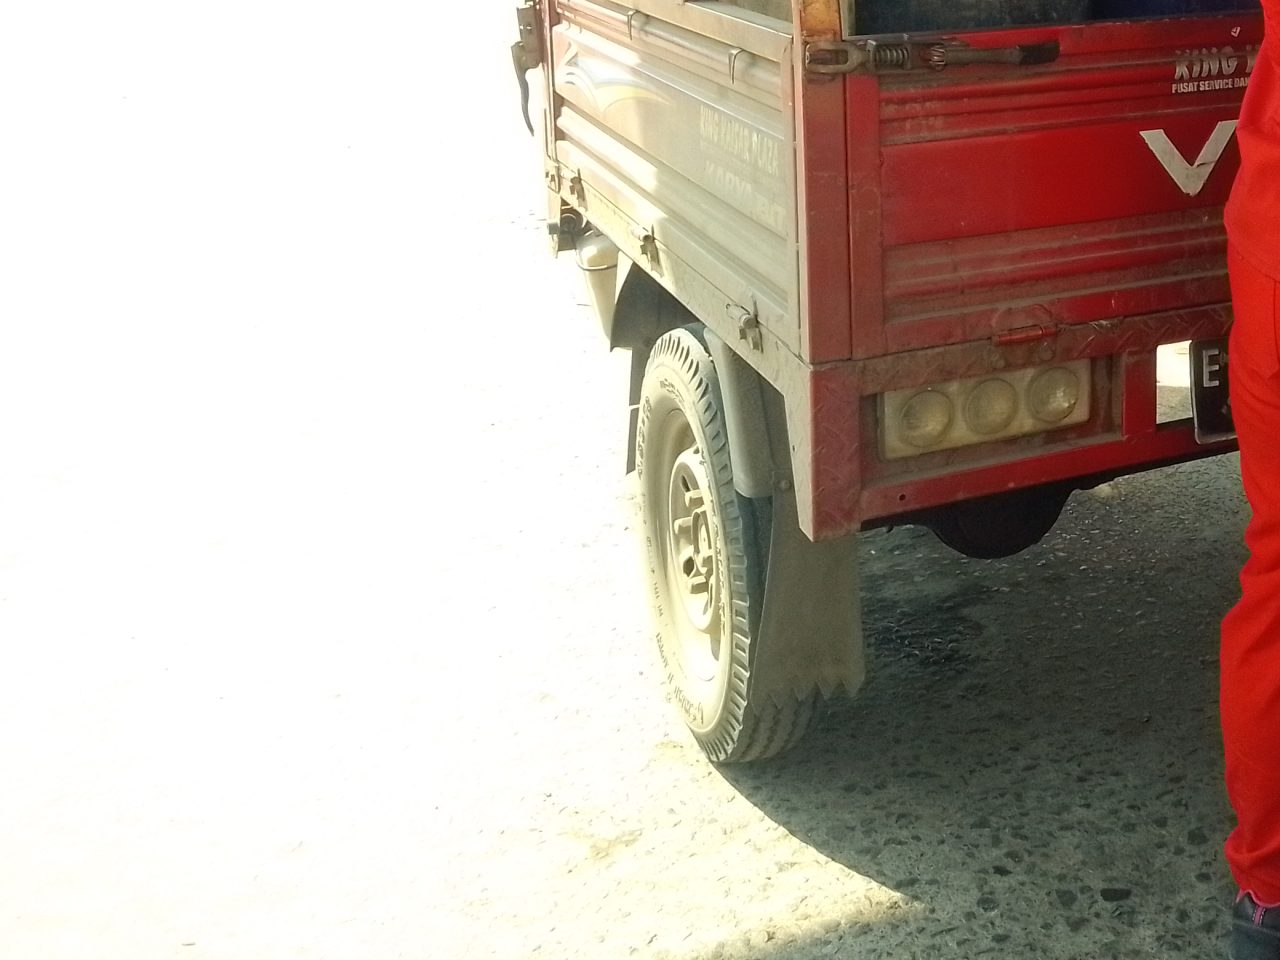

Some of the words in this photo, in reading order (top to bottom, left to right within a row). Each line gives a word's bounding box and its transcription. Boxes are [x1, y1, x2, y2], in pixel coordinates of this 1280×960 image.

[1174, 45, 1238, 80] KING
[1172, 81, 1198, 94] PUSAT
[1199, 79, 1233, 91] SERVICE
[1202, 348, 1220, 388] E
